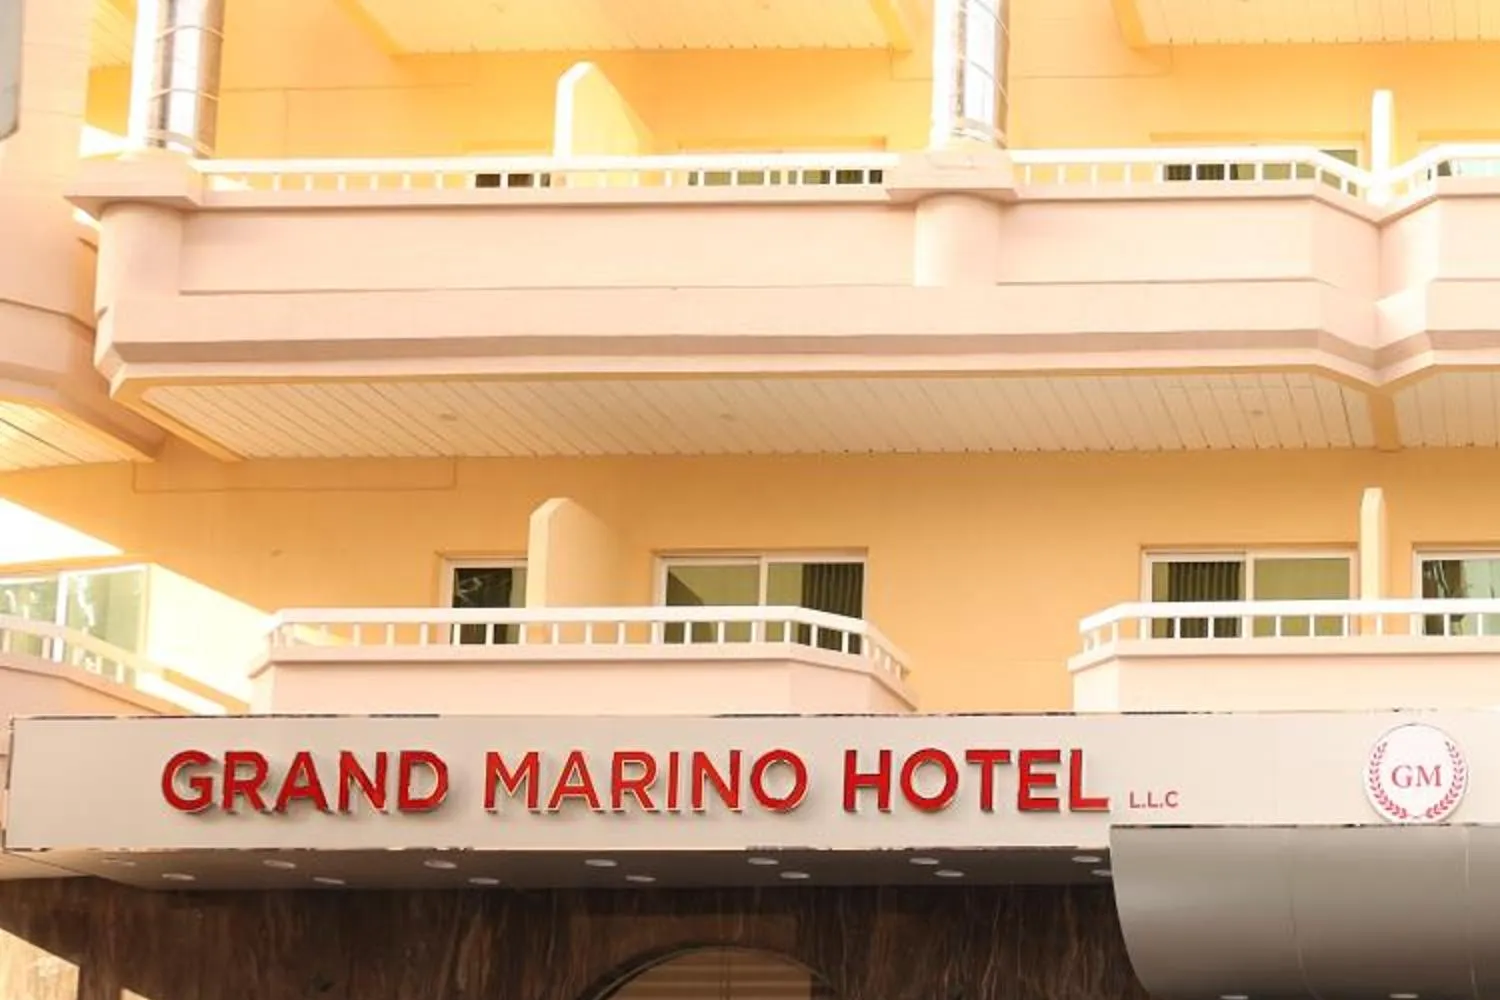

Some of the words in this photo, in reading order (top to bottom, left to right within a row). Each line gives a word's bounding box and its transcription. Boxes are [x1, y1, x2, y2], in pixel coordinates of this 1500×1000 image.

[161, 749, 450, 814] GRAND
[484, 749, 808, 813] MARINO
[843, 747, 1111, 813] HOTEL
[1129, 790, 1179, 809] L.L.C
[1391, 764, 1442, 788] GM
